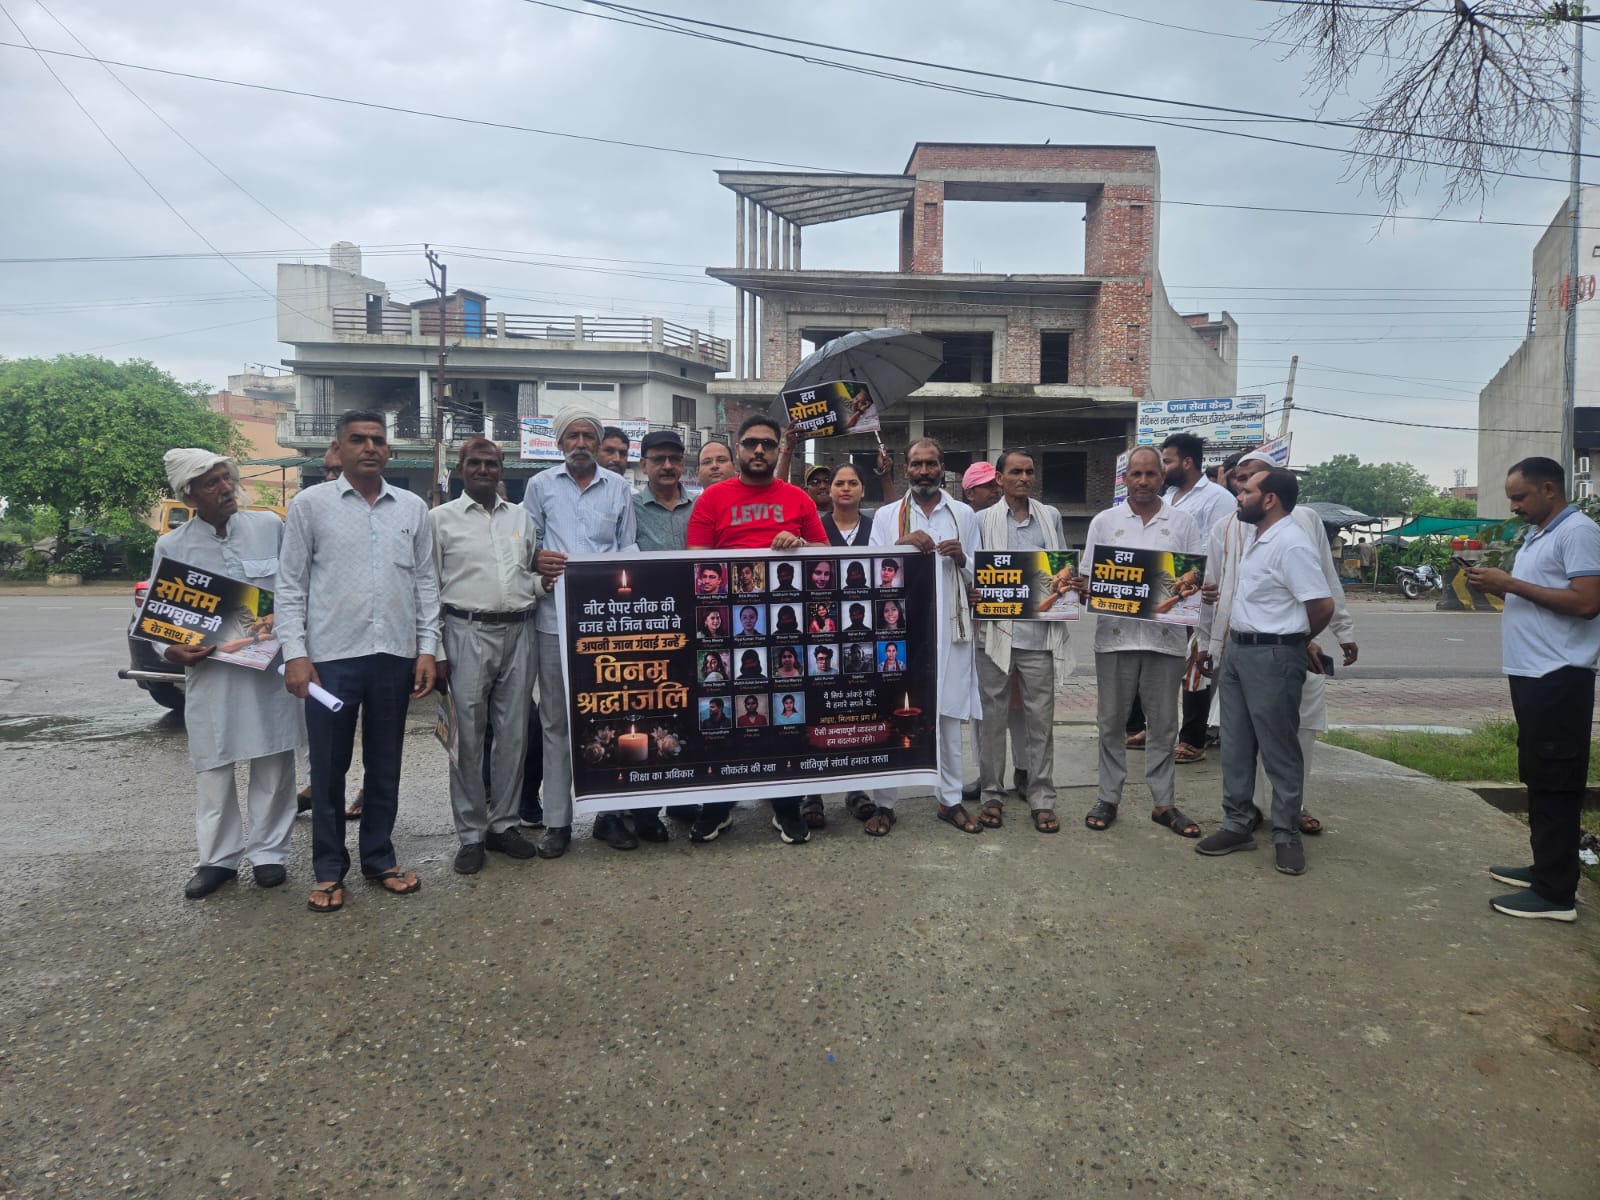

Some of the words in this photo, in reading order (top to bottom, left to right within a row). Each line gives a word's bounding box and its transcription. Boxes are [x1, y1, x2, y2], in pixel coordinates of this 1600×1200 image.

[800, 391, 815, 403] हम
[789, 400, 828, 420] सोनम
[1189, 402, 1207, 411] सेवा
[825, 410, 837, 423] जी
[730, 503, 785, 526] LEVI'S
[993, 554, 1012, 568] हम
[1114, 550, 1135, 564] हम
[186, 570, 213, 588] हम
[976, 564, 1023, 585] सोनम
[1094, 558, 1145, 583] सोनम
[155, 576, 222, 614] सोनम
[1016, 584, 1031, 599] जी
[1091, 579, 1134, 599] वांगचुक
[1134, 583, 1150, 599] जी
[583, 599, 605, 616] नीट
[607, 598, 631, 615] पेपर
[632, 597, 658, 614] लीक
[660, 596, 675, 612] की
[982, 603, 992, 613] के
[992, 605, 1009, 614] साथ
[1108, 601, 1126, 611] साथ
[147, 599, 203, 626] वांगचुक
[201, 615, 223, 632] जी
[578, 621, 603, 633] वजह
[606, 617, 617, 632] से
[619, 616, 643, 632] जिन
[645, 615, 670, 630] बच्चों
[671, 614, 682, 629] ने
[150, 621, 163, 634] के
[164, 627, 184, 642] साथ
[581, 638, 609, 651] अपनी
[612, 639, 633, 650] जान
[661, 634, 681, 648] उन्हें
[593, 654, 670, 684] विनम्र
[577, 681, 689, 715] श्रद्धांजलि
[833, 699, 847, 709] हमारे
[814, 726, 827, 736] ऐसी
[720, 764, 749, 776] लोकतंत्र
[750, 762, 760, 774] की
[762, 763, 777, 773] रक्षा
[800, 758, 829, 772] शांतिपूर्ण
[831, 756, 849, 768] संघर्ष
[851, 757, 869, 766] हमारा
[871, 754, 889, 763] रास्ता
[629, 771, 650, 783] शिक्षा
[651, 771, 662, 781] का
[664, 767, 694, 780] अधिकार
